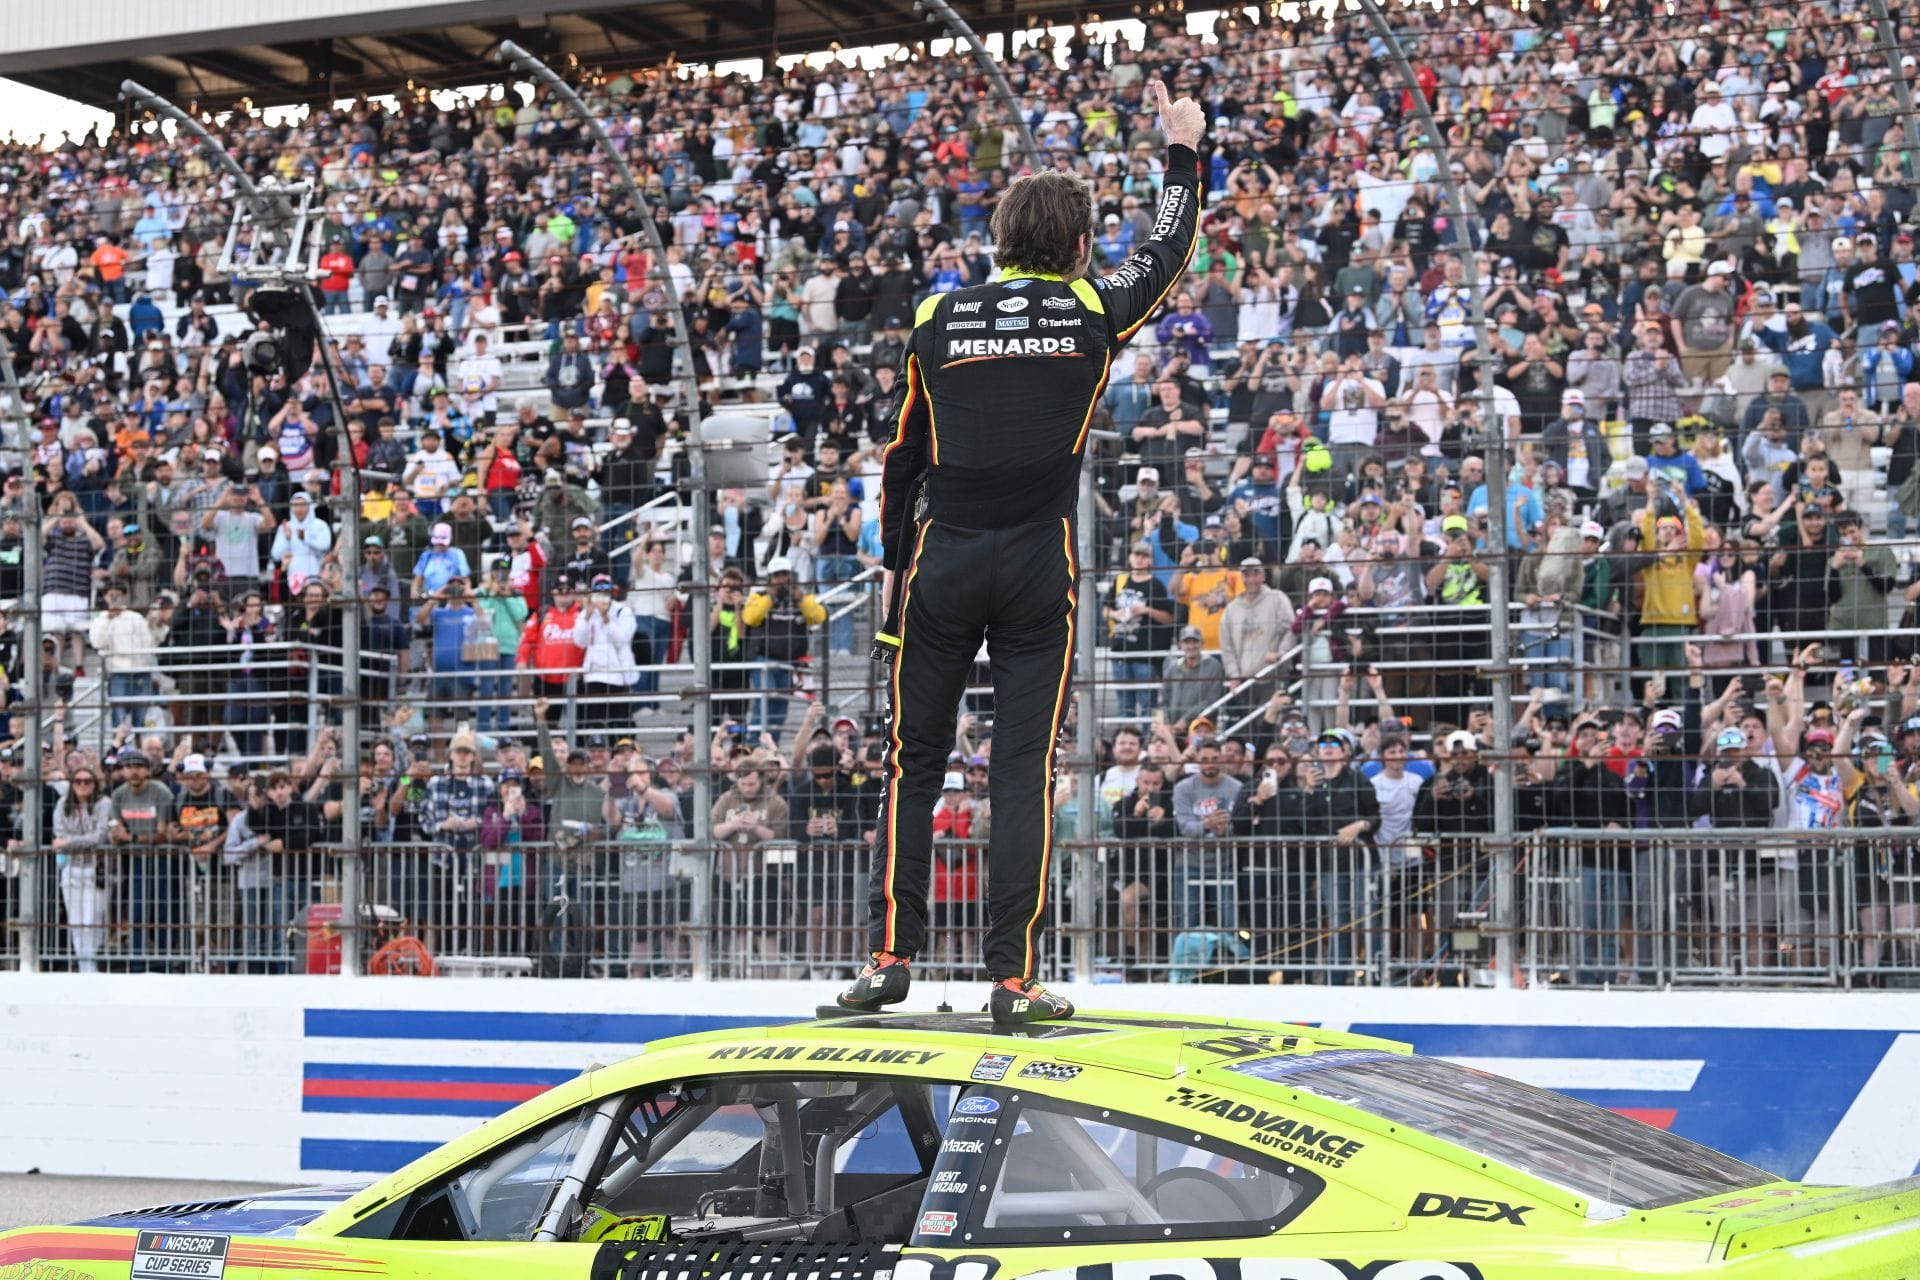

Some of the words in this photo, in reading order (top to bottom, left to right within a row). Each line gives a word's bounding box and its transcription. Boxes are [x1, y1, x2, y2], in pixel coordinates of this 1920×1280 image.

[953, 301, 983, 314] KNAUF
[1000, 299, 1025, 309] Scotts
[1042, 297, 1076, 308] Richmond
[998, 318, 1028, 328] MAYTAG
[1049, 318, 1082, 327] Tarkett
[949, 337, 1076, 355] MENARDS
[869, 974, 886, 988] 12
[1012, 999, 1030, 1013] 12
[708, 1046, 806, 1060] RYAN
[806, 1047, 945, 1065] BLANEY
[962, 1099, 991, 1111] Ford
[1199, 1099, 1365, 1159] ADVANCE
[941, 1139, 985, 1154] Mazak
[1249, 1132, 1295, 1152] AUTO
[1294, 1146, 1345, 1169] PARTS
[935, 1171, 961, 1182] DENT
[931, 1182, 968, 1194] WIZARD
[1407, 1192, 1537, 1226] DEX
[165, 1236, 215, 1253] NASCAR
[145, 1256, 170, 1271] CUP
[170, 1258, 211, 1274] SERIES
